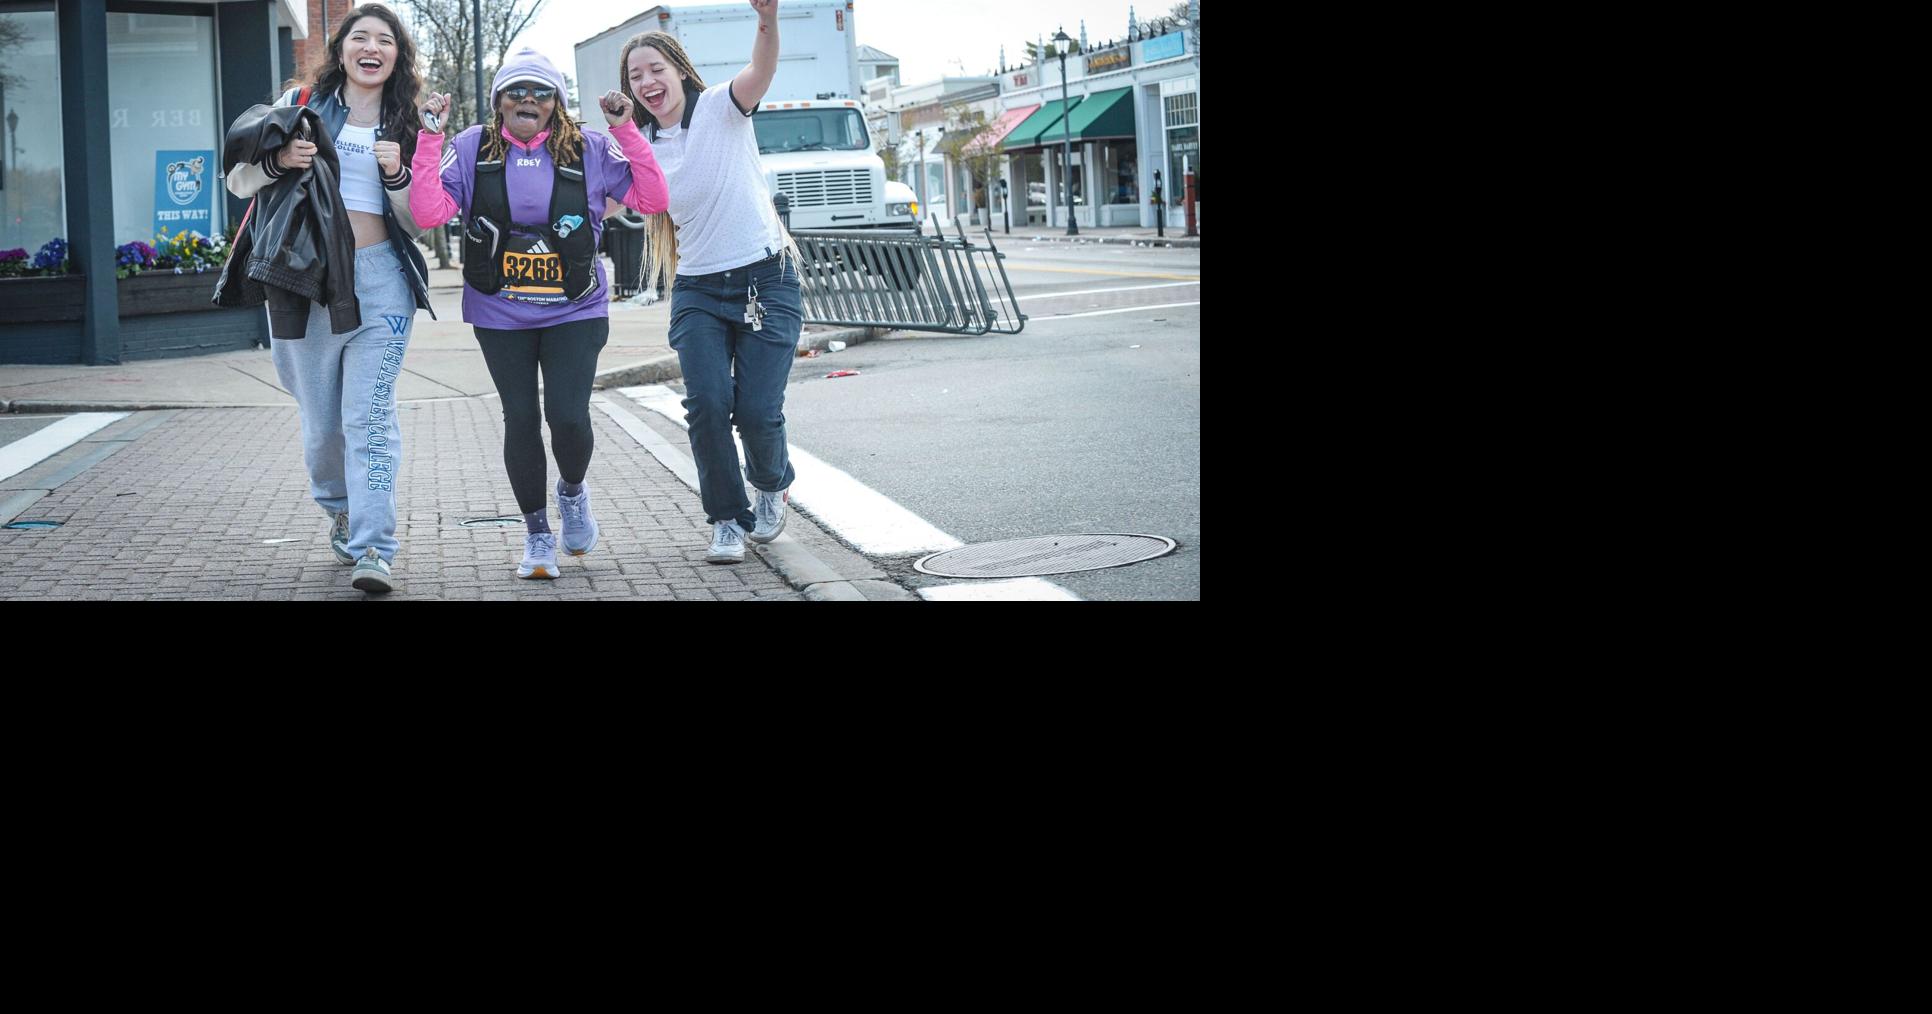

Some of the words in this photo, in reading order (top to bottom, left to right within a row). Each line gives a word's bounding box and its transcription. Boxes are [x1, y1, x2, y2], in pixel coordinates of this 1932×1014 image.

[335, 140, 370, 151] ELLESLEY
[336, 145, 365, 154] OLLEGE
[173, 171, 189, 181] MY
[175, 181, 197, 191] GYM
[157, 210, 180, 221] THIS
[181, 209, 208, 220] WAY!
[506, 255, 559, 281] 3268
[382, 315, 409, 336] W
[368, 339, 405, 424] WELLESLEY
[366, 424, 393, 492] COLLEGE
